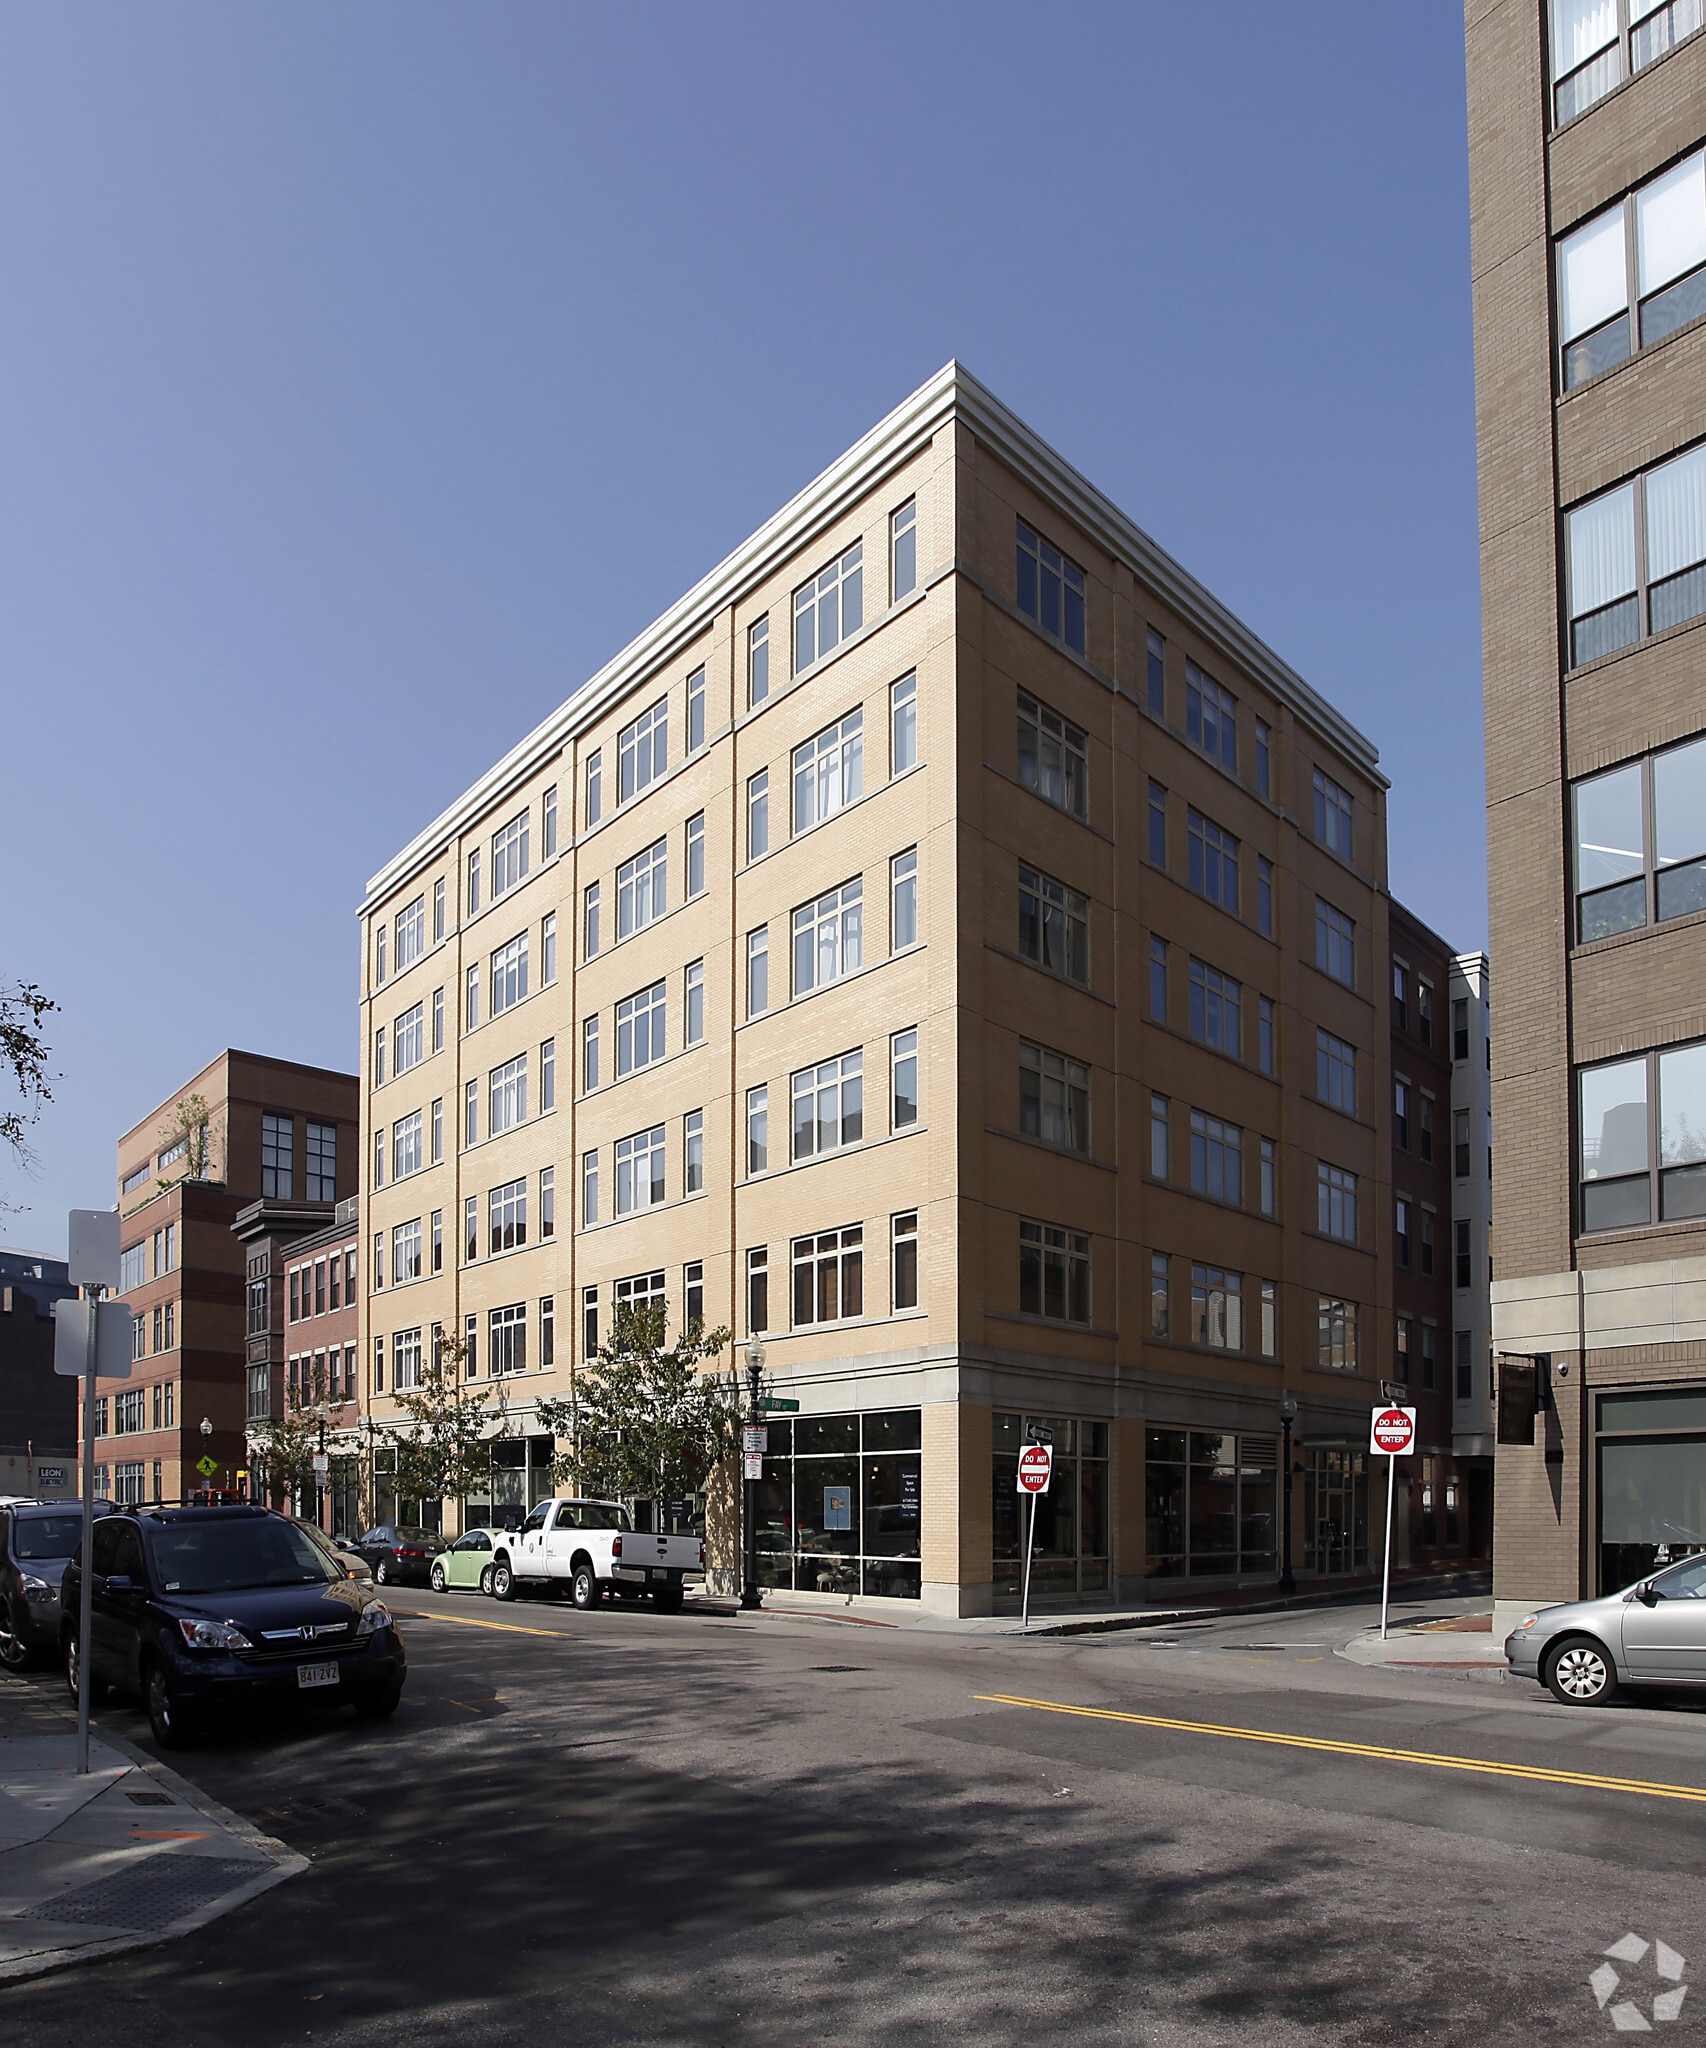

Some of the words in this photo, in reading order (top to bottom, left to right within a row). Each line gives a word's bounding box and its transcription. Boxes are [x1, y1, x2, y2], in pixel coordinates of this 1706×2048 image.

[771, 1400, 782, 1409] FAY
[1025, 1455, 1034, 1463] DO
[1037, 1455, 1047, 1463] NOT
[41, 1468, 62, 1477] LEON
[1025, 1475, 1044, 1483] ENTER
[301, 1671, 316, 1682] 841
